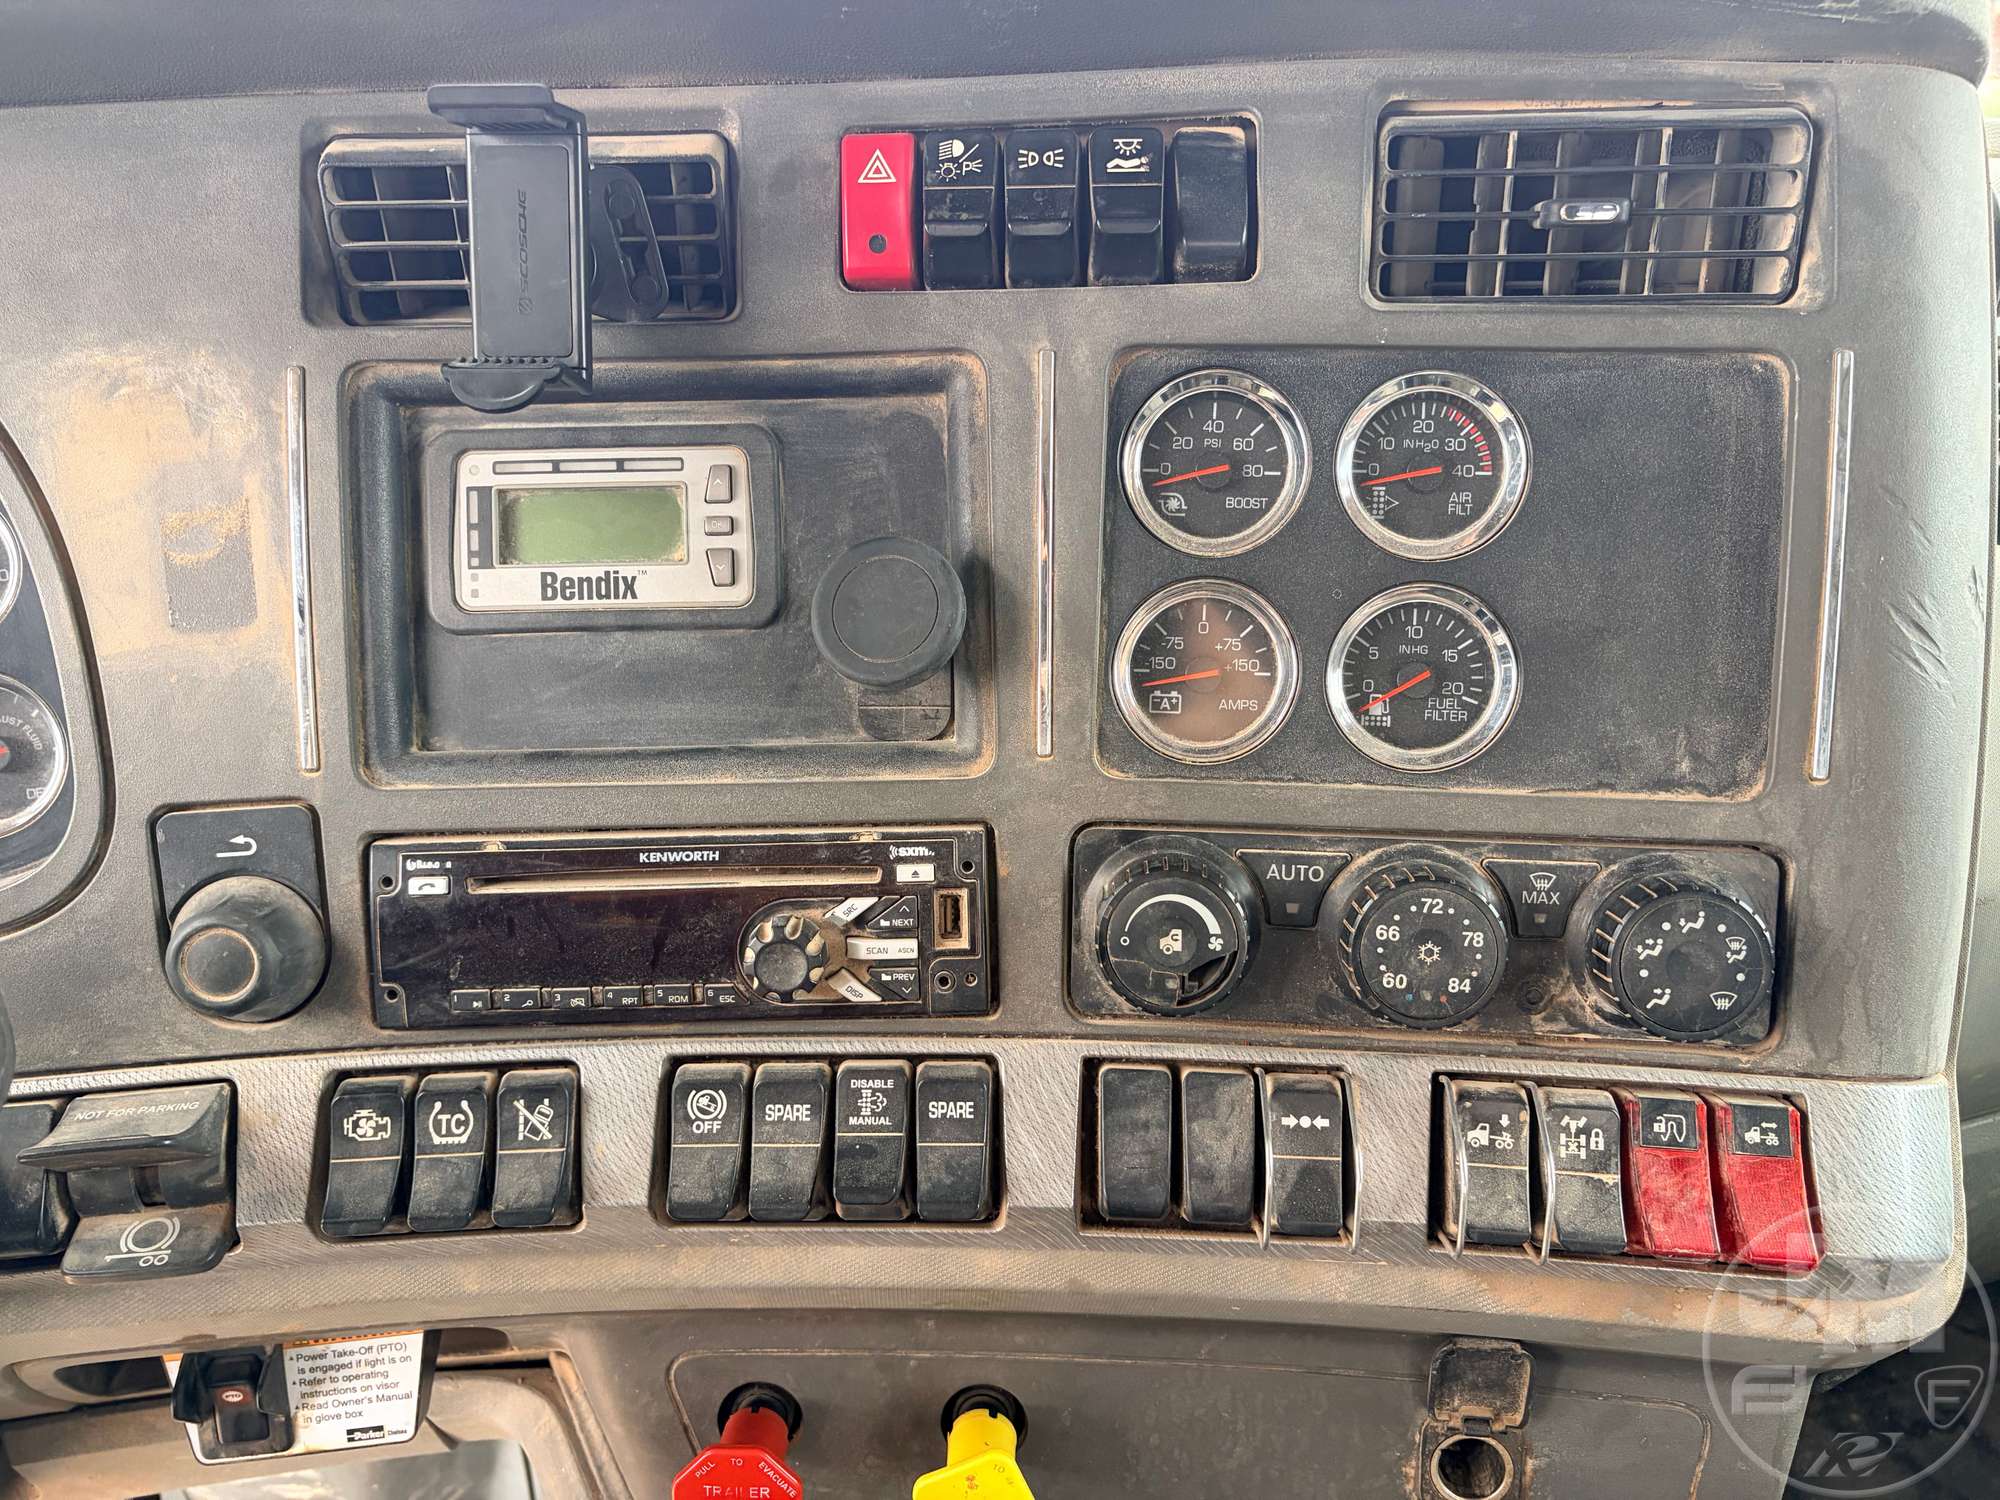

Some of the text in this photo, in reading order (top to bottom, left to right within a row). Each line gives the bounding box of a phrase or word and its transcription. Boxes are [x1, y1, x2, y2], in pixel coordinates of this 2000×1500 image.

[1202, 420, 1224, 433] 40
[1413, 420, 1434, 433] 20
[1172, 437, 1193, 449] 20
[1204, 439, 1222, 448] PSI
[1233, 438, 1254, 451] 60
[1377, 437, 1395, 450] 10
[1444, 438, 1466, 451] 30
[1160, 463, 1171, 475] 0
[1242, 464, 1263, 477] 80
[1368, 463, 1379, 475] 0
[1452, 465, 1474, 477] 40
[1225, 497, 1268, 509] BOOST
[1449, 492, 1472, 503] AIR
[1448, 504, 1473, 516] FILT
[540, 570, 639, 601] Bendix
[1198, 621, 1209, 634] 0
[1405, 626, 1423, 639] 10
[1161, 636, 1184, 650] -75
[1215, 638, 1241, 651] +75
[1368, 646, 1379, 660] 5
[1442, 649, 1458, 662] 15
[1145, 656, 1176, 669] -150
[1224, 659, 1260, 672] +150
[1362, 679, 1374, 692] 0
[1441, 681, 1464, 695] 20
[1219, 699, 1258, 711] AMPS
[1428, 697, 1461, 709] FUEL
[1424, 709, 1468, 722] FILTER
[639, 851, 720, 863] KENWORTH
[1266, 864, 1324, 881] AUTO
[1521, 890, 1560, 905] MAX
[842, 903, 858, 918] SRC
[1420, 898, 1444, 915] 72
[892, 918, 914, 926] NEXT
[1375, 925, 1400, 942] 66
[1462, 931, 1484, 948] 78
[866, 947, 888, 955] SCAN
[893, 973, 915, 981] PREV
[1382, 973, 1407, 990] 60
[845, 985, 864, 999] DISP
[1447, 977, 1472, 994] 84
[503, 993, 511, 1001] 2
[554, 993, 561, 1001] 3
[607, 991, 613, 999] 4
[657, 989, 663, 997] 5
[707, 989, 714, 997] 6
[719, 995, 736, 1003] ESC
[622, 997, 638, 1005] RPT
[850, 1078, 894, 1089] DISABLE
[74, 1101, 200, 1121] NOT FOR PARKING
[765, 1104, 811, 1122] SPARE
[928, 1101, 974, 1119] SPARE
[436, 1114, 466, 1132] TC
[692, 1120, 722, 1134] OFF
[848, 1115, 892, 1126] MANUAL
[296, 1342, 407, 1363] Power Take-Off (PTO)
[297, 1366, 306, 1375] is
[309, 1361, 353, 1375] engaged
[364, 1356, 385, 1368] light
[388, 1356, 396, 1365] is
[399, 1354, 412, 1363] on
[298, 1369, 389, 1387] Refer to operating
[300, 1381, 400, 1400] instructions on visor
[301, 1391, 413, 1412] Read Owner's Manual
[303, 1409, 363, 1424] in glove box
[354, 1430, 384, 1440] Parker
[695, 1457, 798, 1498] PULL TO EVACUATE
